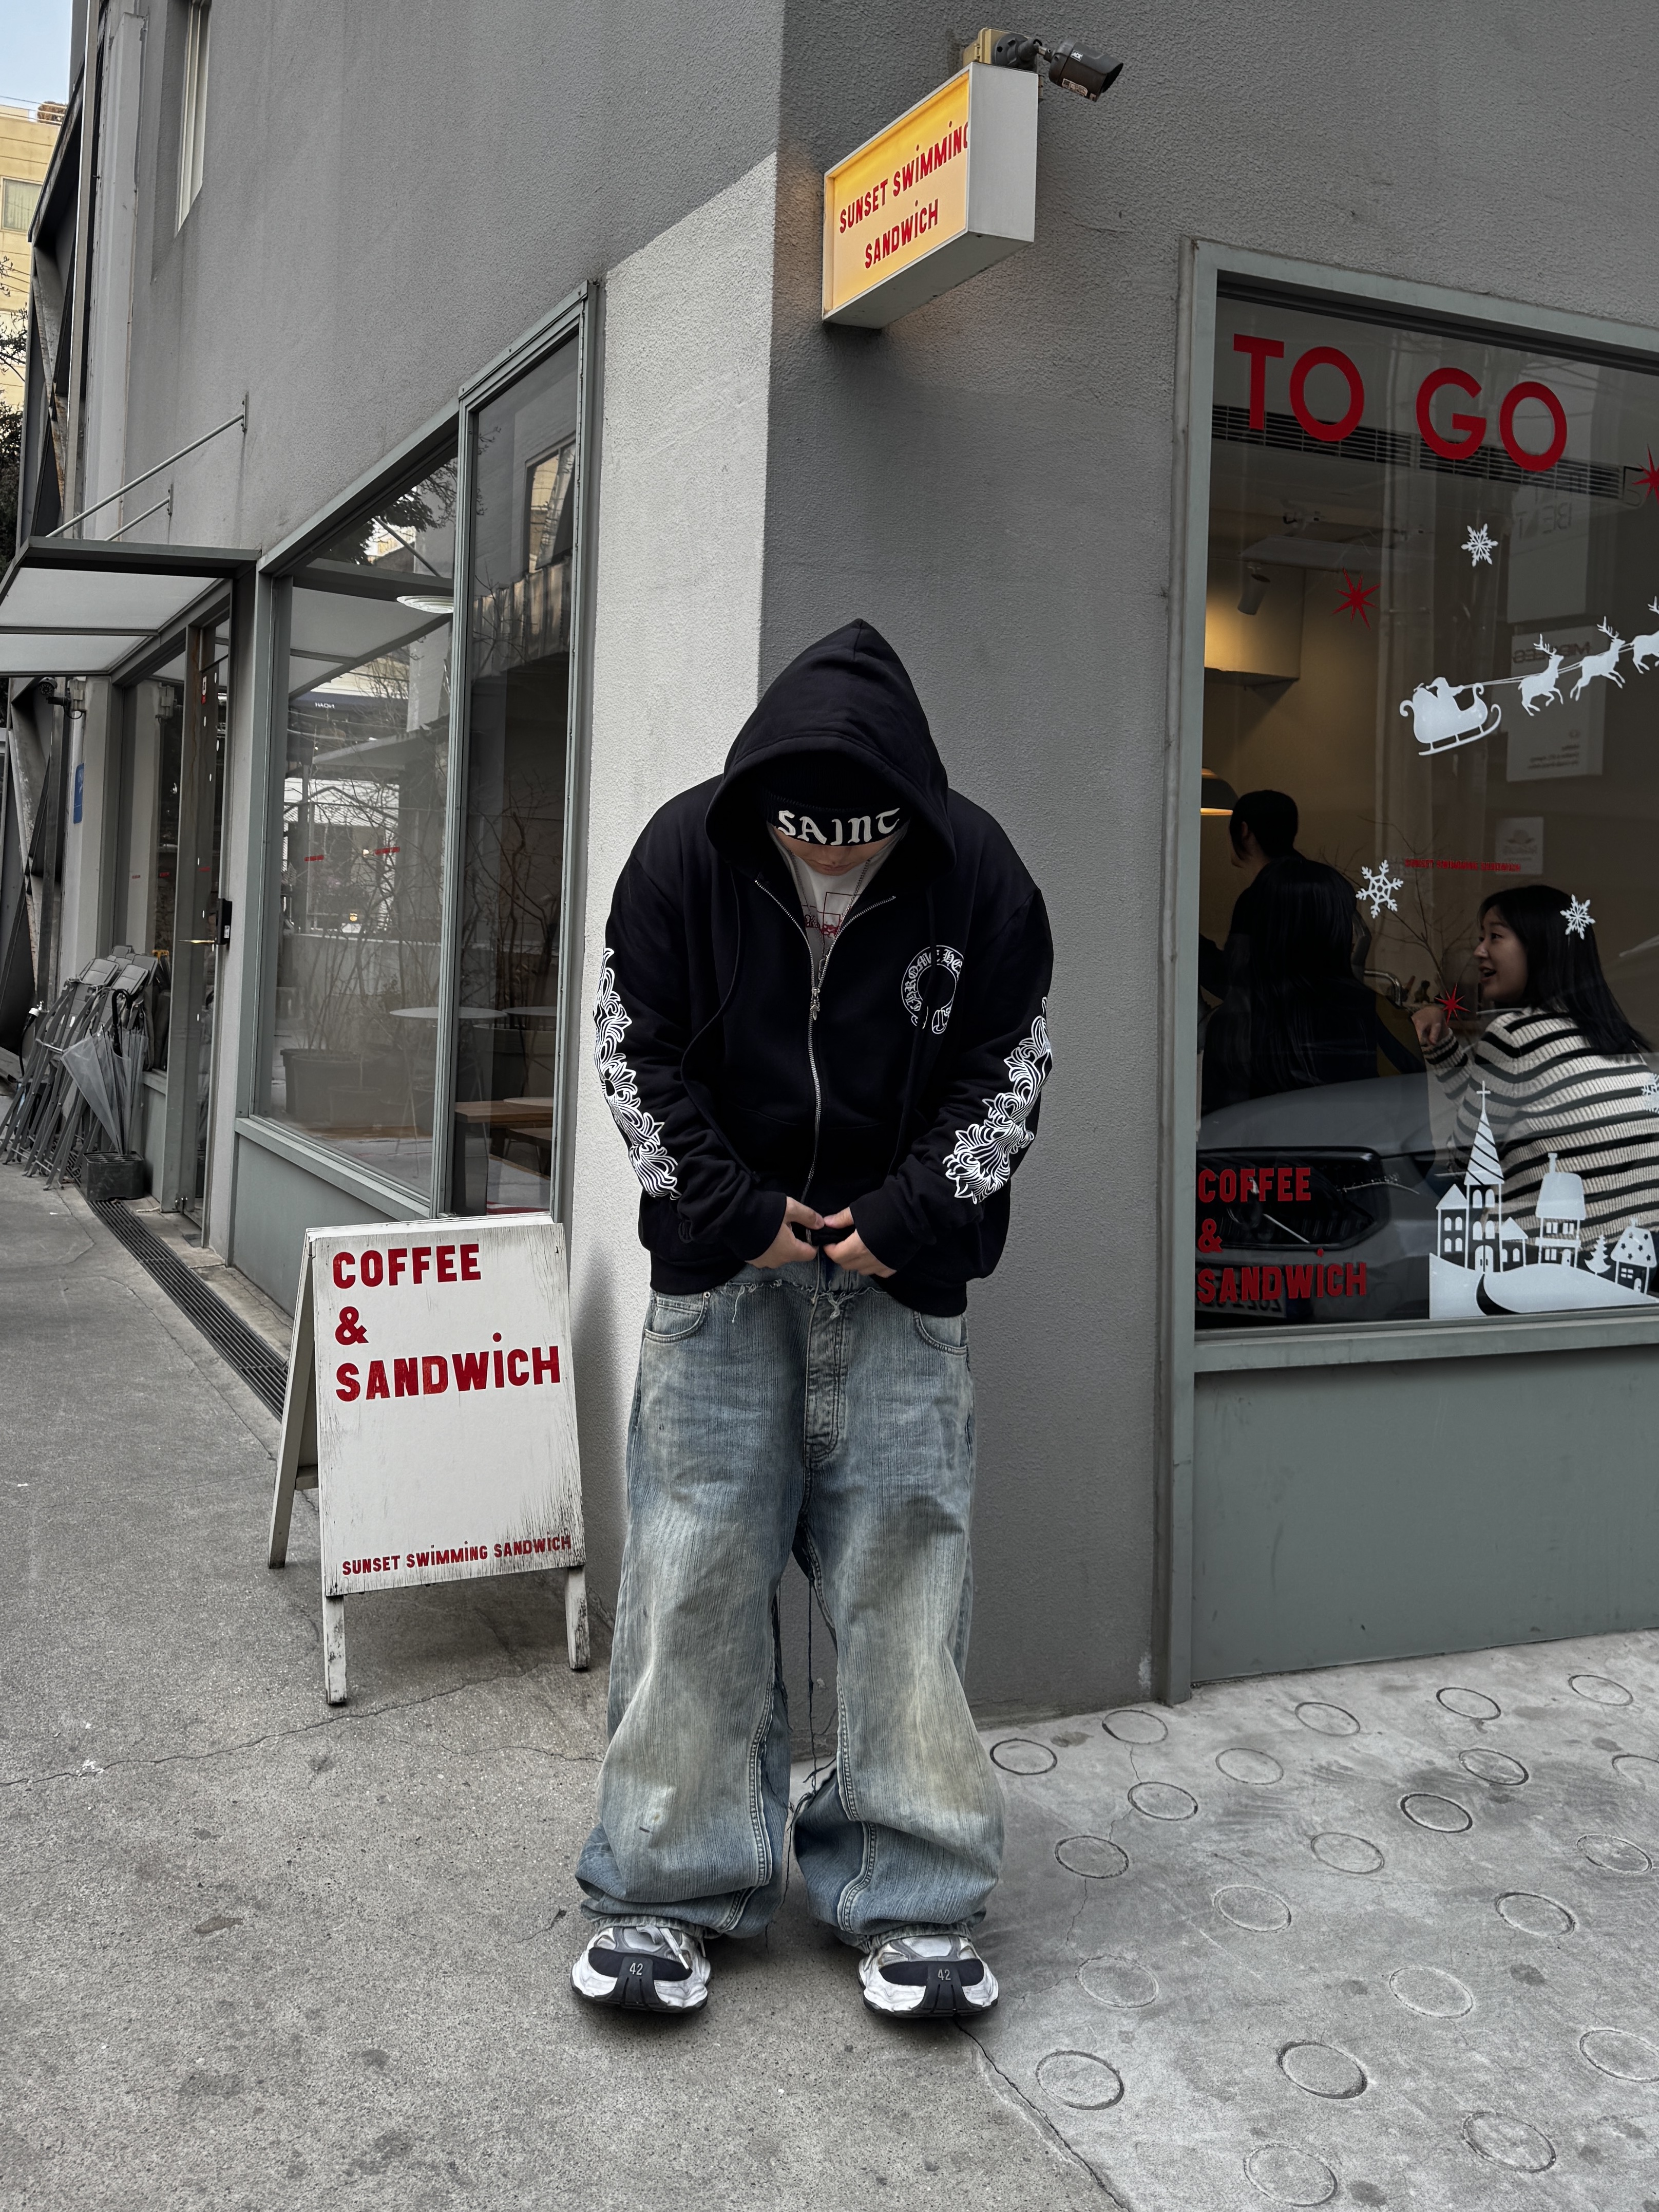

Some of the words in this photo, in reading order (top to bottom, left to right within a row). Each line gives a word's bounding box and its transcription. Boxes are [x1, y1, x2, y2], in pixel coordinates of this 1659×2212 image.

[840, 179, 888, 234] SUNSET
[1233, 334, 1364, 442] TO
[1416, 368, 1568, 472] GO
[777, 807, 900, 846] SAINT
[1198, 1167, 1311, 1203] COFFEE
[1198, 1218, 1223, 1253] &
[332, 1244, 481, 1290] COFFEE
[334, 1306, 369, 1346] &
[342, 1555, 400, 1576] SUNSET
[629, 1962, 643, 1976] 42
[937, 1969, 951, 1981] 42
